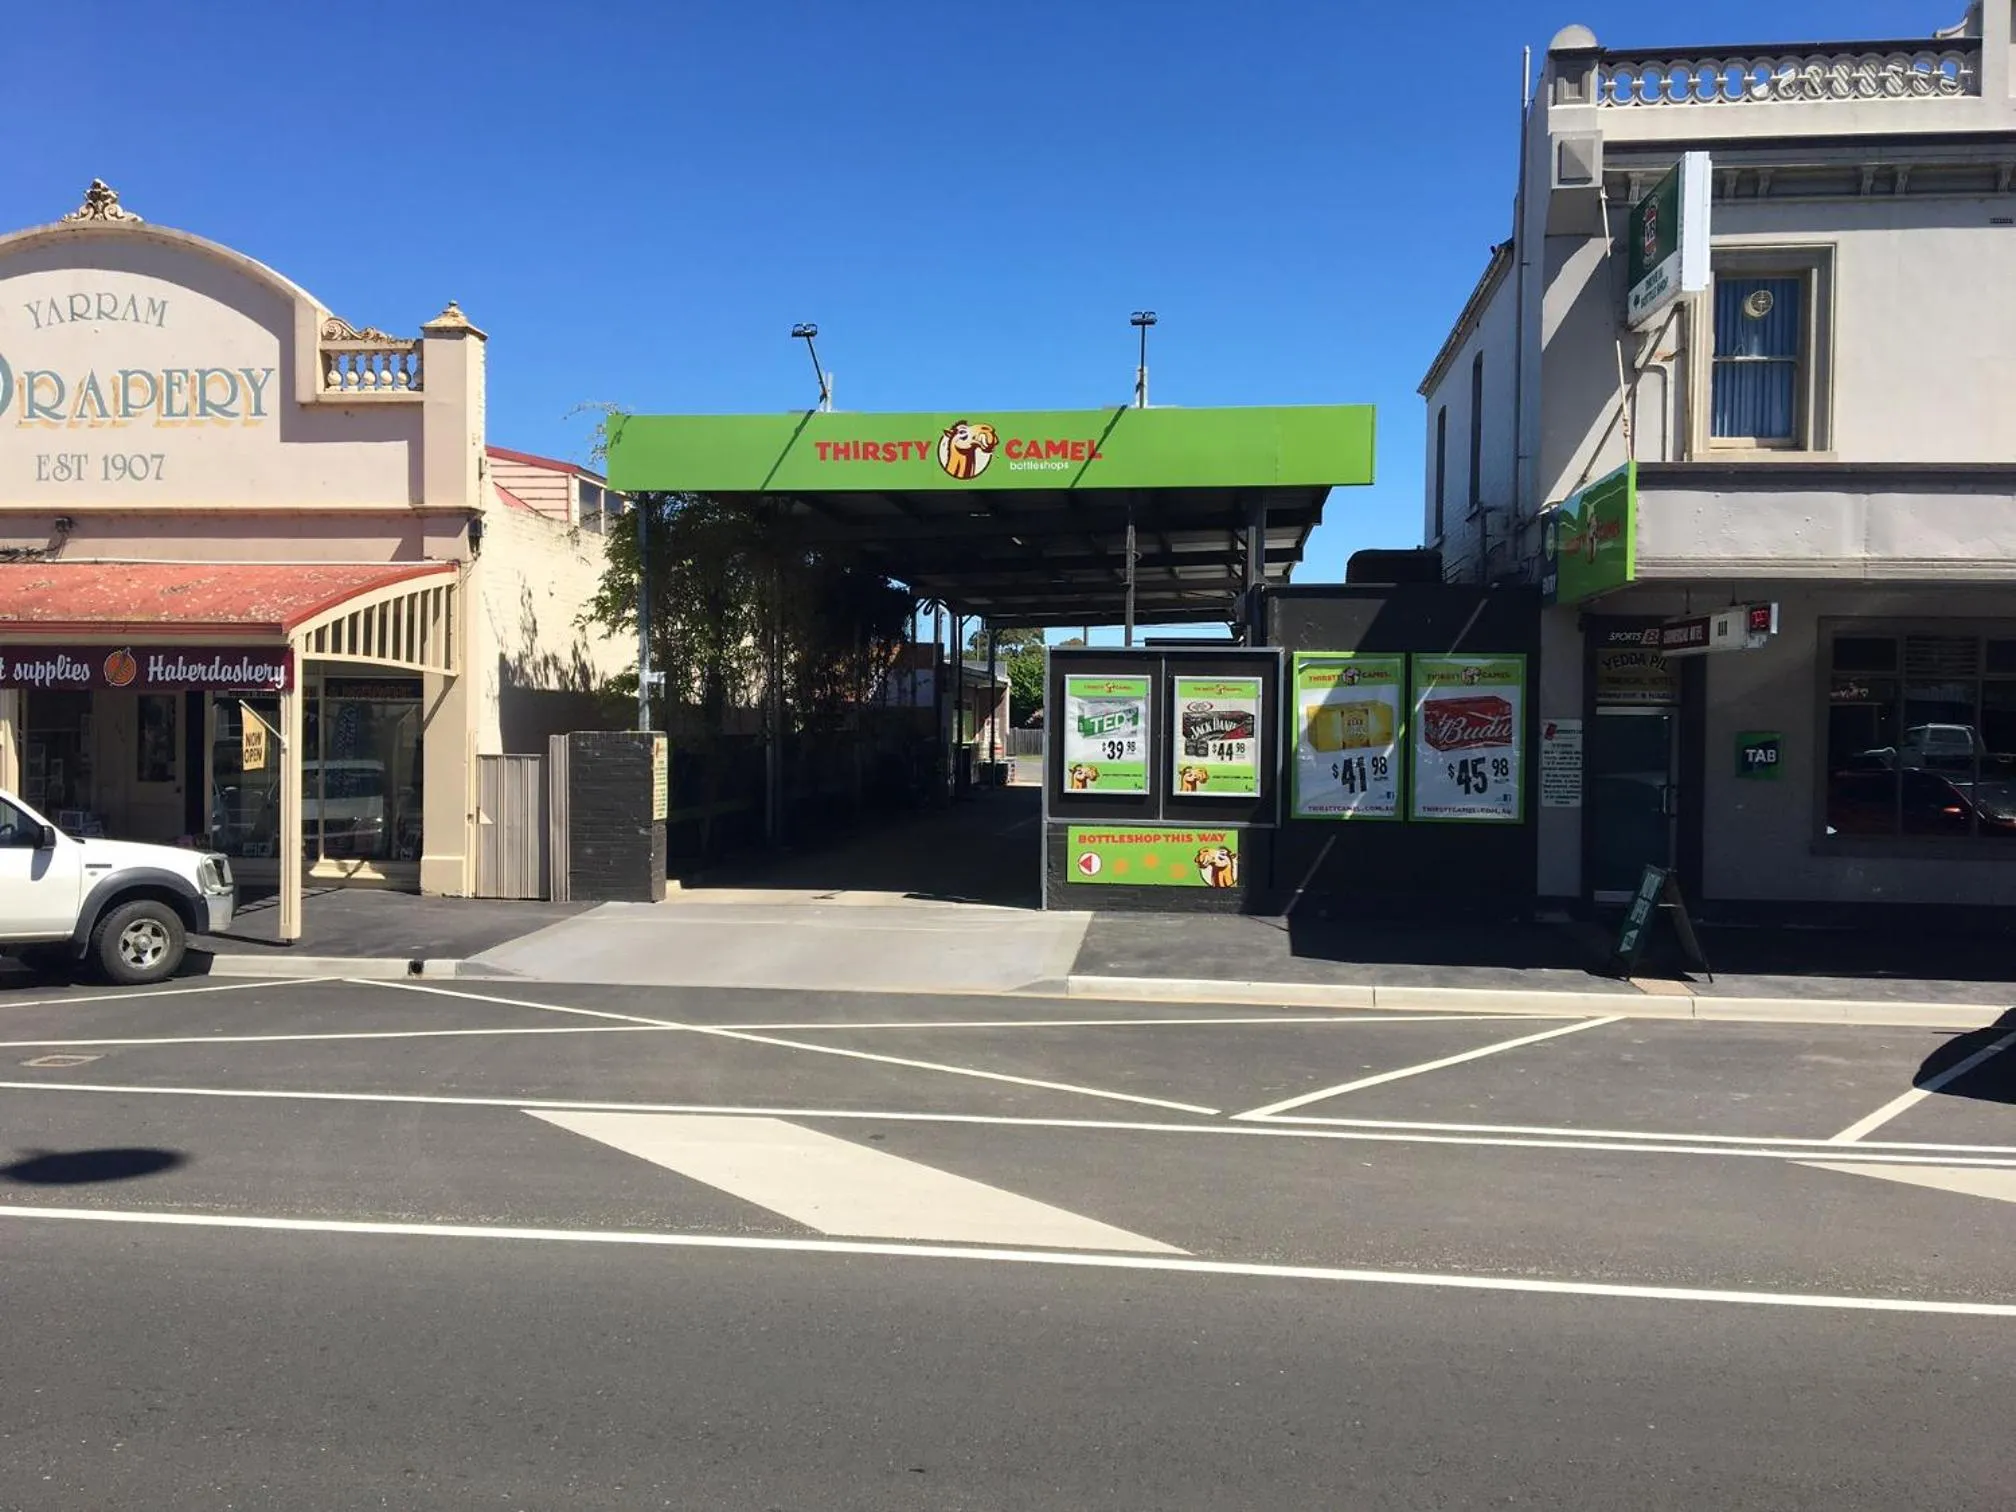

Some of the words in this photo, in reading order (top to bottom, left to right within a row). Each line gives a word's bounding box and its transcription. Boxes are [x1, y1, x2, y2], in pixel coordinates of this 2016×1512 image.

[25, 293, 169, 328] YARRAM
[0, 351, 275, 426] RAPERY
[815, 440, 932, 463] THIRSTY
[1004, 438, 1103, 461] CAMEL
[36, 453, 89, 482] EST
[101, 453, 166, 482] 1907
[1009, 460, 1070, 472] bottleshops
[1609, 631, 1643, 642] SPORTS
[13, 655, 91, 687] supplies
[147, 655, 287, 689] Haberdashery
[1090, 712, 1126, 734] TED
[1191, 719, 1213, 740] JACK
[245, 731, 263, 747] NOW
[243, 747, 263, 764] OPEN
[1744, 748, 1777, 763] TAB
[1371, 756, 1389, 776] 98
[1491, 757, 1510, 777] 98
[1078, 832, 1162, 845] BOTTLESHOP
[1164, 832, 1193, 845] THIS
[1197, 832, 1227, 844] WAY
